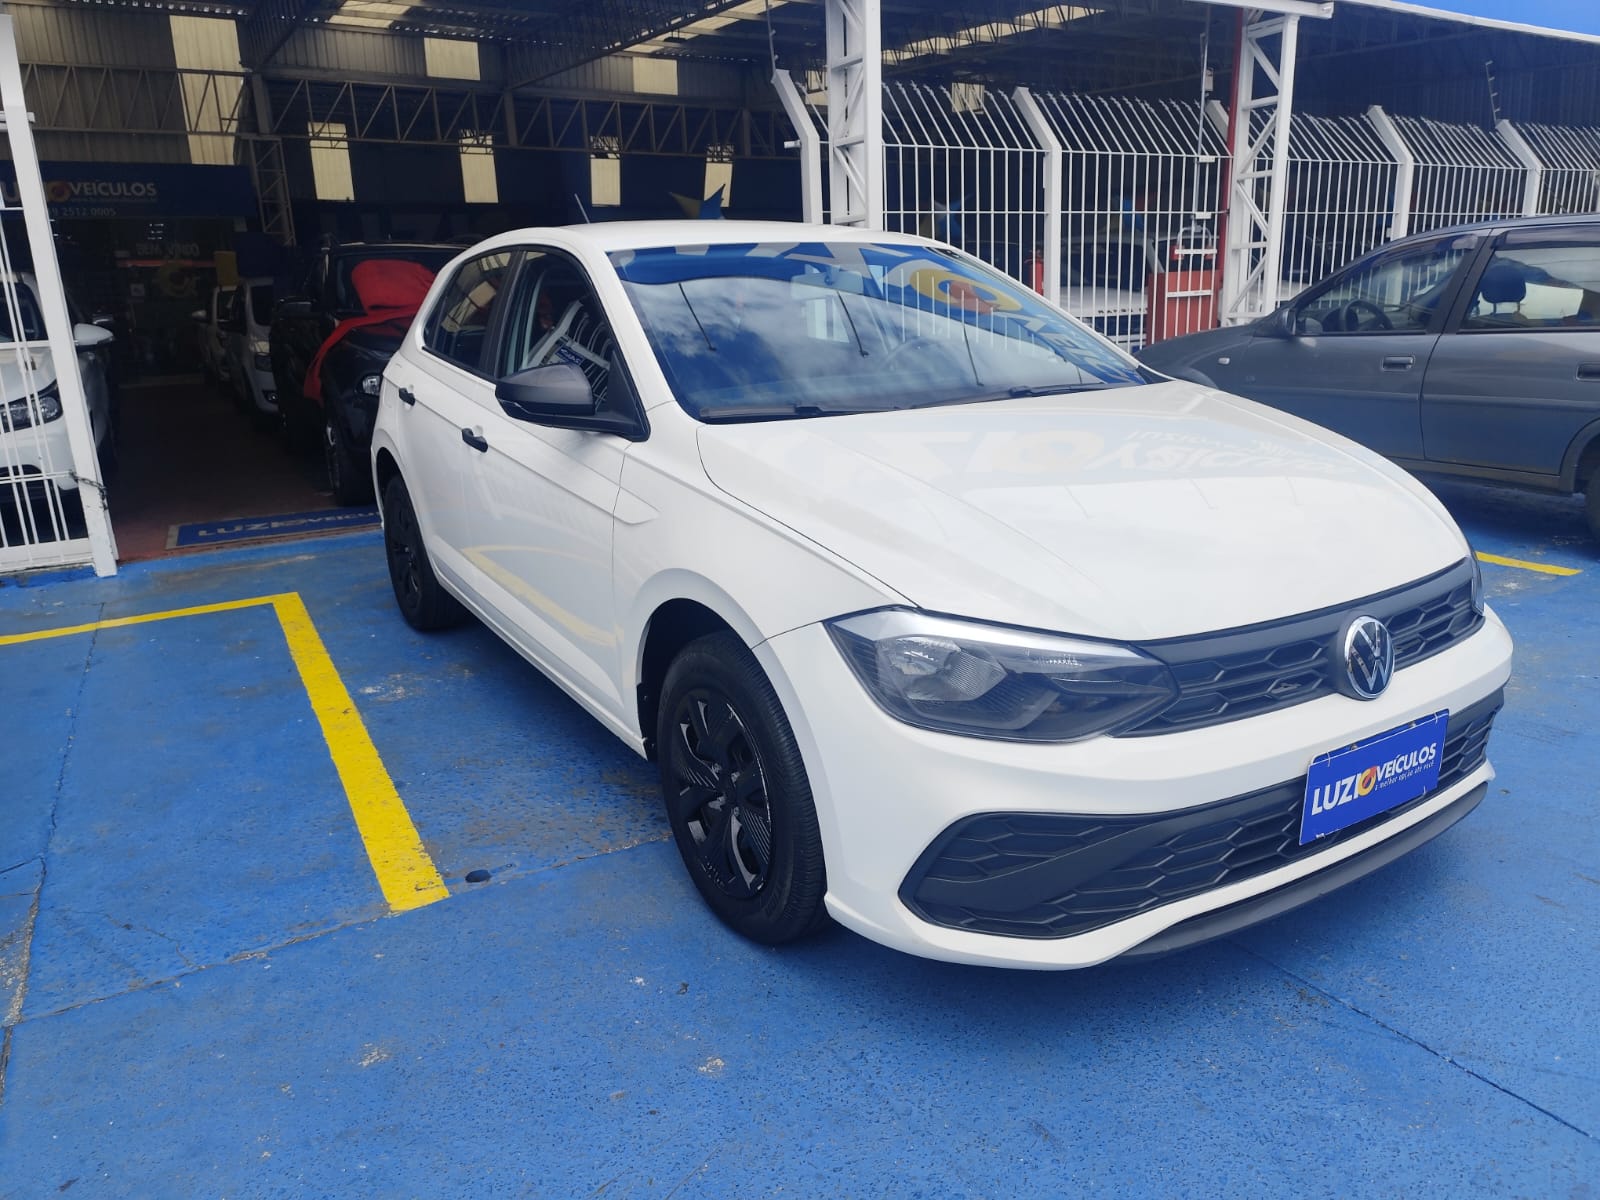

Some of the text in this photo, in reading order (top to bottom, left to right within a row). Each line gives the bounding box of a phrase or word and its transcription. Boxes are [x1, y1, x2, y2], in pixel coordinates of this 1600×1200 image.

[69, 180, 157, 196] VEÍCULOS
[198, 519, 307, 536] LUZIO
[1311, 743, 1437, 815] LUZIO VEÍCULOS
